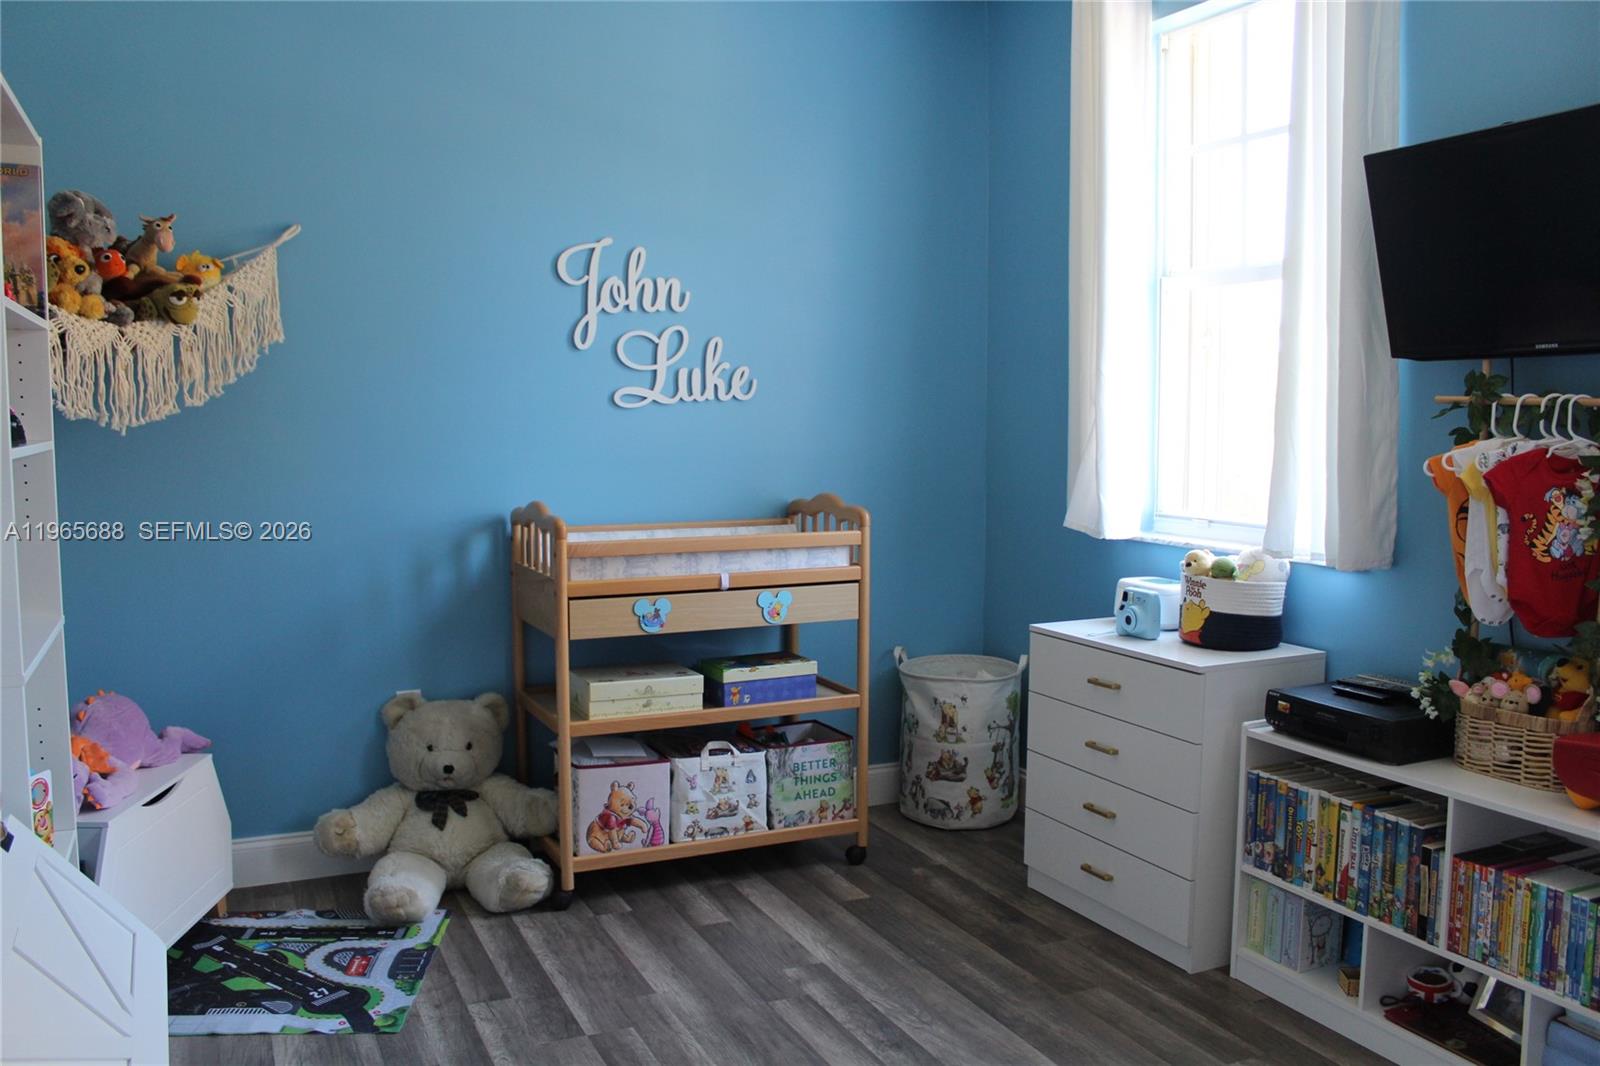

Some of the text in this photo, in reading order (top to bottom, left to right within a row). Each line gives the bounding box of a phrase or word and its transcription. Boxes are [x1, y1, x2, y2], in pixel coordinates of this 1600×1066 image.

[556, 237, 690, 351] John
[612, 324, 757, 409] Luke
[1185, 585, 1202, 598] Pooh
[792, 758, 837, 773] BETTER
[793, 772, 837, 786] THINGS
[794, 787, 836, 801] AHEAD
[309, 987, 329, 999] 27
